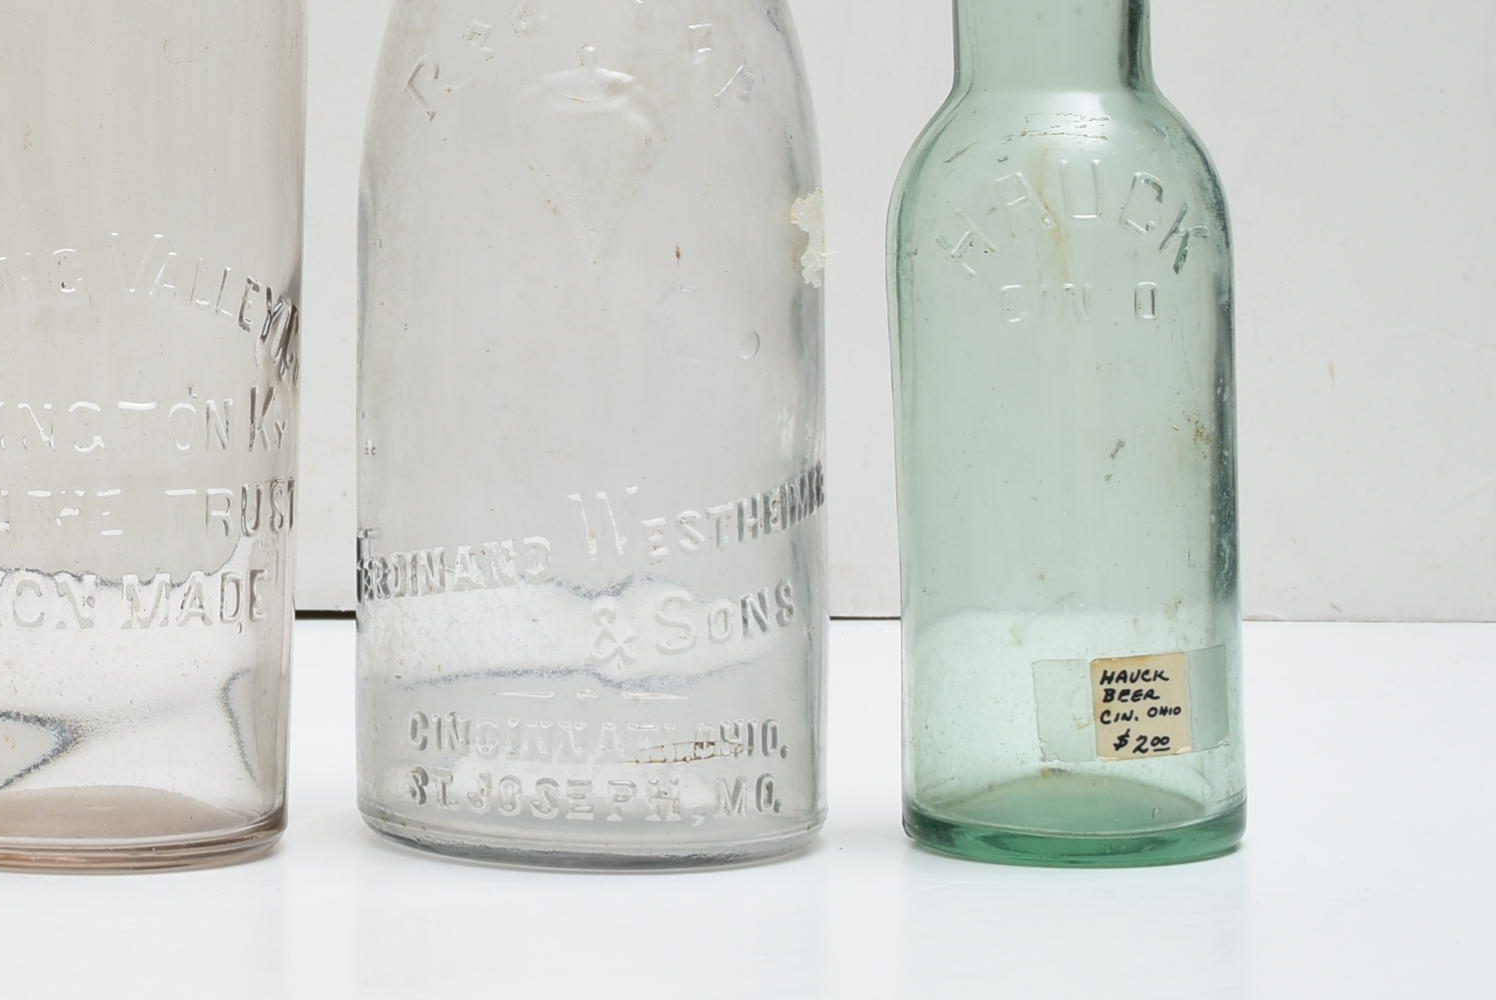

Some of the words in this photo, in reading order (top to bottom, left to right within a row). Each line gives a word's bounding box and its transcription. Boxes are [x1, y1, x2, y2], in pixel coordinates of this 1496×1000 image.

[934, 158, 1210, 277] HAUCK
[106, 231, 285, 345] VALLEY
[120, 566, 268, 630] MADE
[583, 596, 639, 666] &
[654, 577, 797, 657] SONS
[1099, 669, 1171, 685] HAUCK
[1101, 687, 1161, 703] BEER
[1099, 708, 1139, 725] CIN.
[1146, 705, 1182, 718] OHIO
